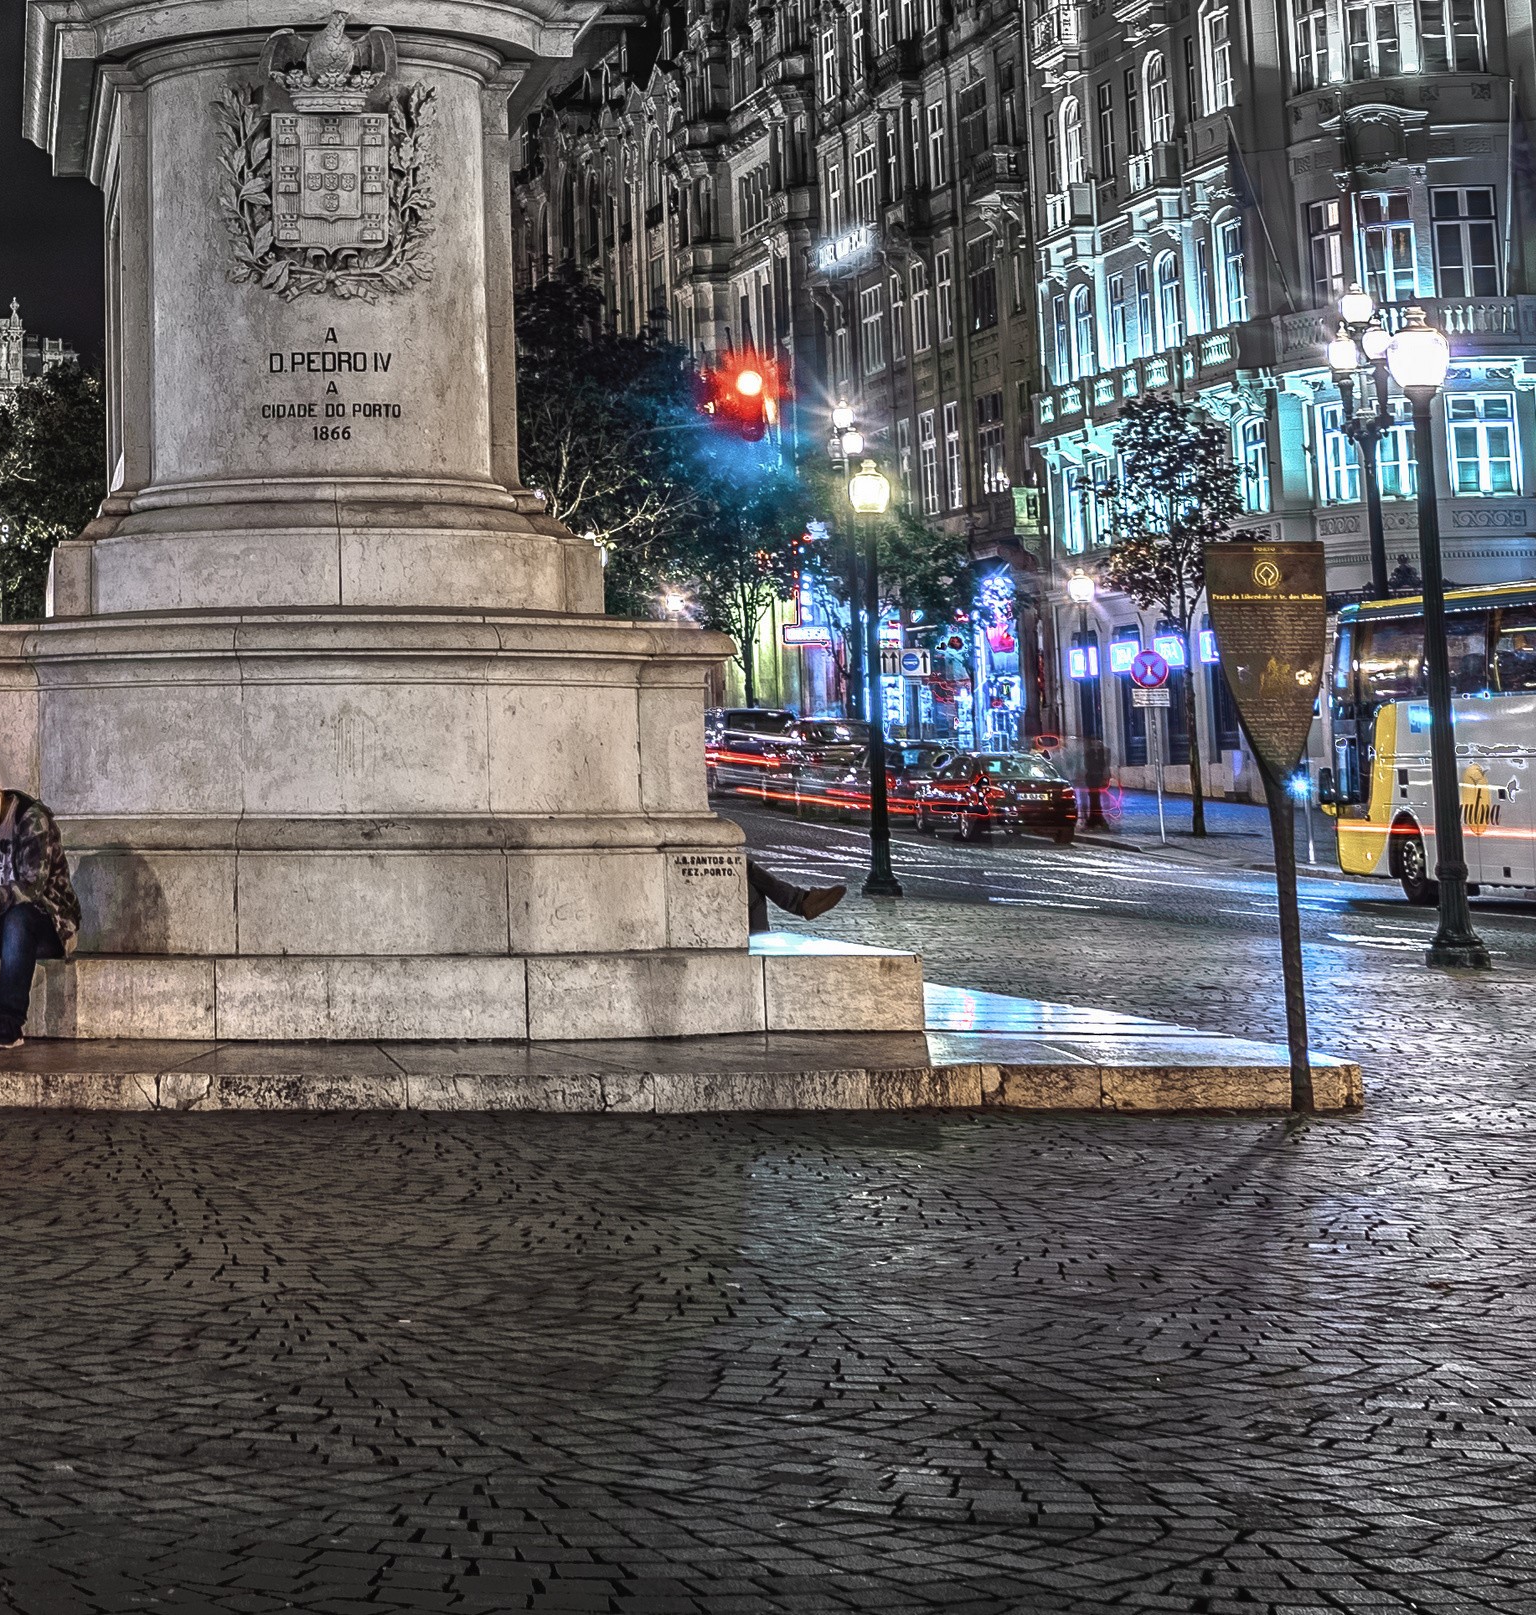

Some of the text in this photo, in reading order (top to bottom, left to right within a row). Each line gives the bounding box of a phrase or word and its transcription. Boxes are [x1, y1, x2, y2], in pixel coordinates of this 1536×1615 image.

[324, 327, 338, 344] A
[373, 352, 392, 373] IV
[325, 380, 339, 395] A
[261, 403, 401, 419] CIDADE DO PORTO
[312, 425, 351, 441] 1866
